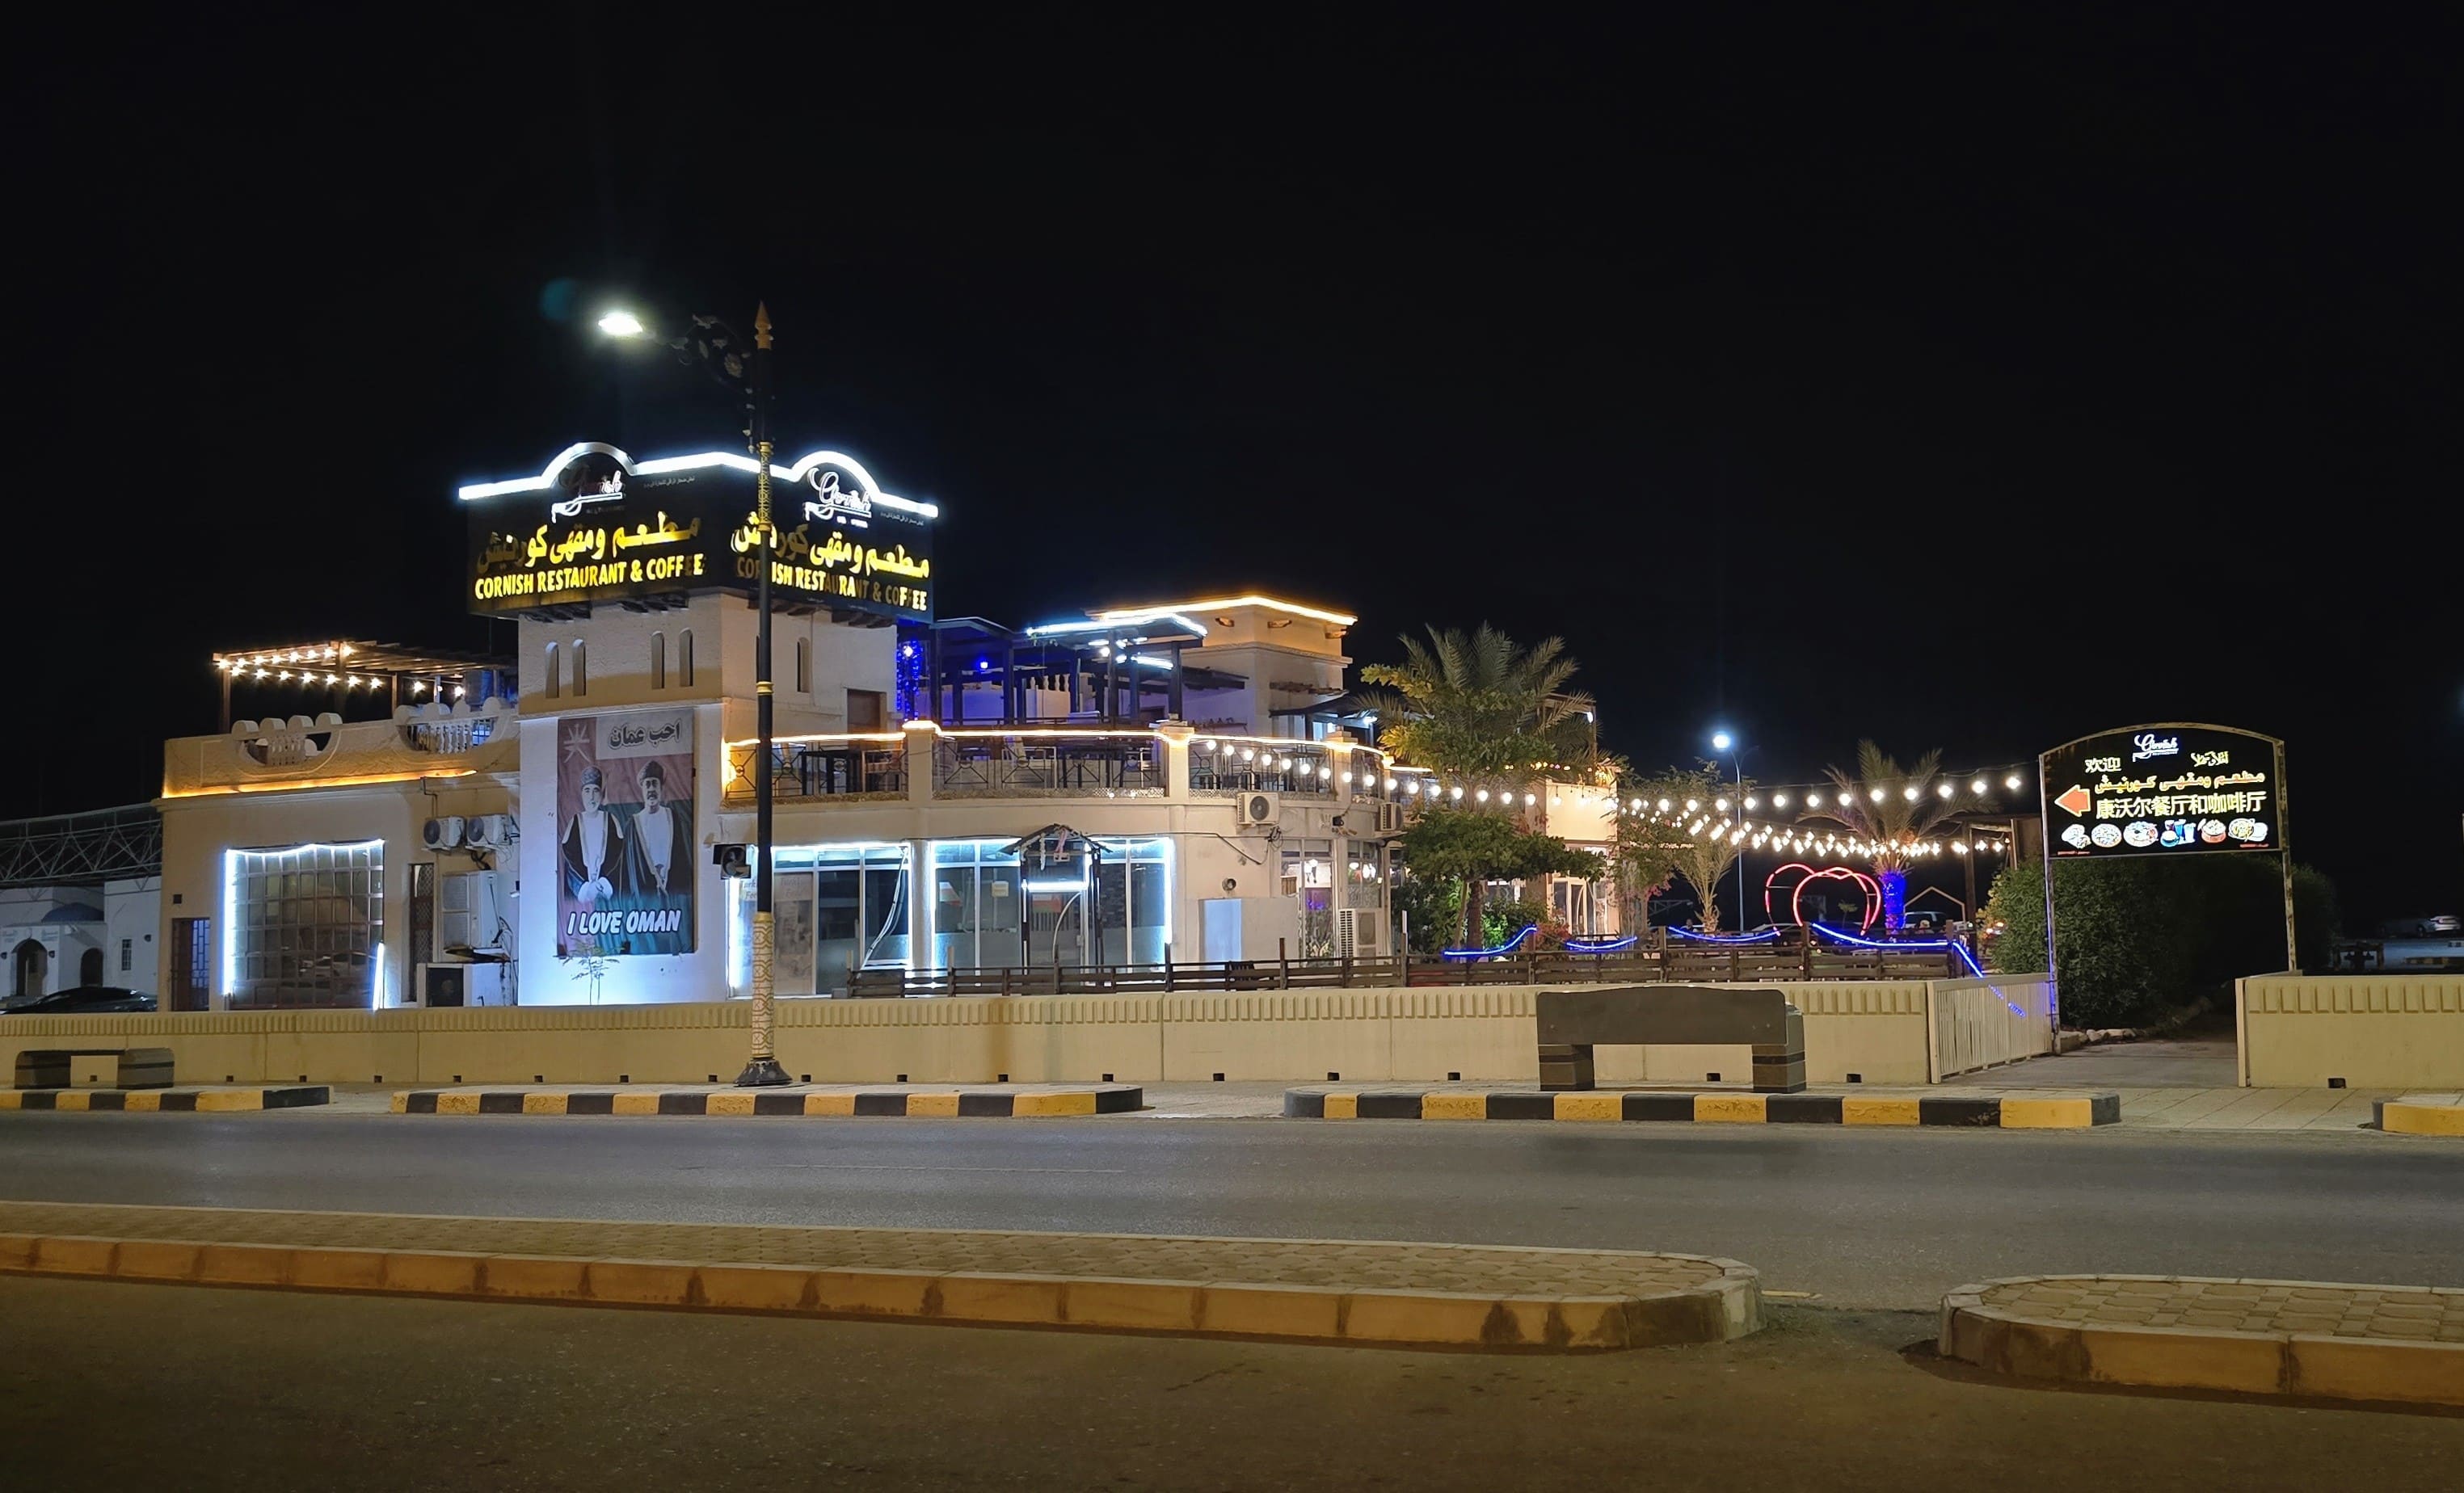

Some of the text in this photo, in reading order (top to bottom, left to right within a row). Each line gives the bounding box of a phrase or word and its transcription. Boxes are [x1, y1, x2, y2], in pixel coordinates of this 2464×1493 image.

[613, 510, 701, 558] مطعم
[866, 543, 930, 579] مطعم
[474, 553, 705, 600] CORNISH RESTAURANT & COFFEE
[736, 556, 928, 612] CORISH RESTAURANT & COFFEE
[609, 725, 645, 749] عمان
[2085, 757, 2121, 773] 欢迎
[2095, 770, 2265, 794] مطعم ومقهى كورنيش
[2096, 791, 2267, 819] 康沃尔餐厅和咖啡厅
[567, 909, 681, 936] I LOVE OMAN
